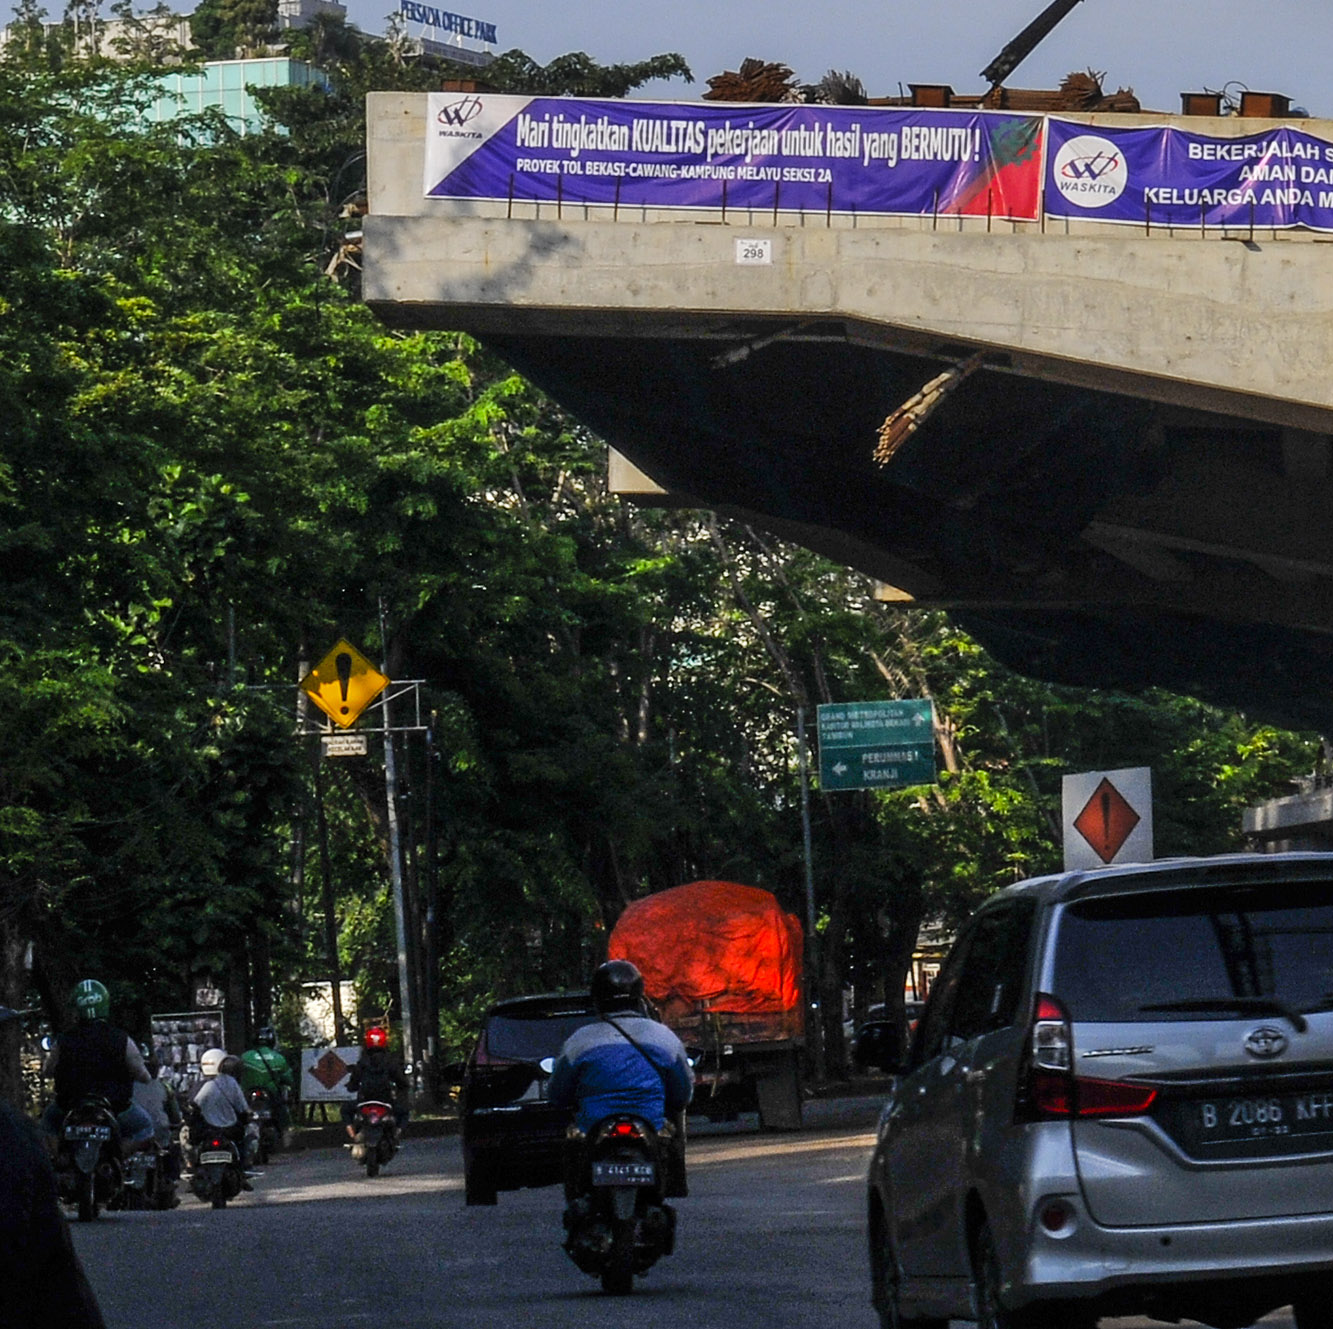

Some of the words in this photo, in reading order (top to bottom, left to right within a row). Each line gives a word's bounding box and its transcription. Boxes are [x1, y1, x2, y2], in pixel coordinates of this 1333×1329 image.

[401, 0, 441, 28] PERSADA
[442, 11, 474, 38] OFFICE
[474, 20, 497, 44] PARK
[438, 130, 483, 139] WASKITA
[516, 113, 549, 147] Mari
[552, 114, 629, 158] tingkatkan
[632, 119, 705, 154] KUALITAS
[707, 120, 778, 163] pekerjaan
[782, 122, 823, 158] untuk
[826, 123, 860, 158] hasil
[863, 131, 898, 168] yang
[901, 126, 971, 162] BERMUTU
[1188, 142, 1320, 162] BEKERJALAH
[516, 158, 560, 174] PROYEK
[562, 160, 583, 175] TOL
[585, 161, 735, 180] BEKASI-CAWANG-KAMPUNG
[737, 167, 781, 182] MELAYU
[783, 168, 816, 182] SEKSI
[817, 169, 832, 183] 2A
[1239, 166, 1296, 182] AMAN
[1060, 181, 1117, 196] WASKITA
[1144, 187, 1254, 206] KELUARGA
[1261, 188, 1314, 207] ANDA
[743, 248, 764, 259] 298
[1203, 1103, 1218, 1128] B
[1229, 1098, 1282, 1126] 2086
